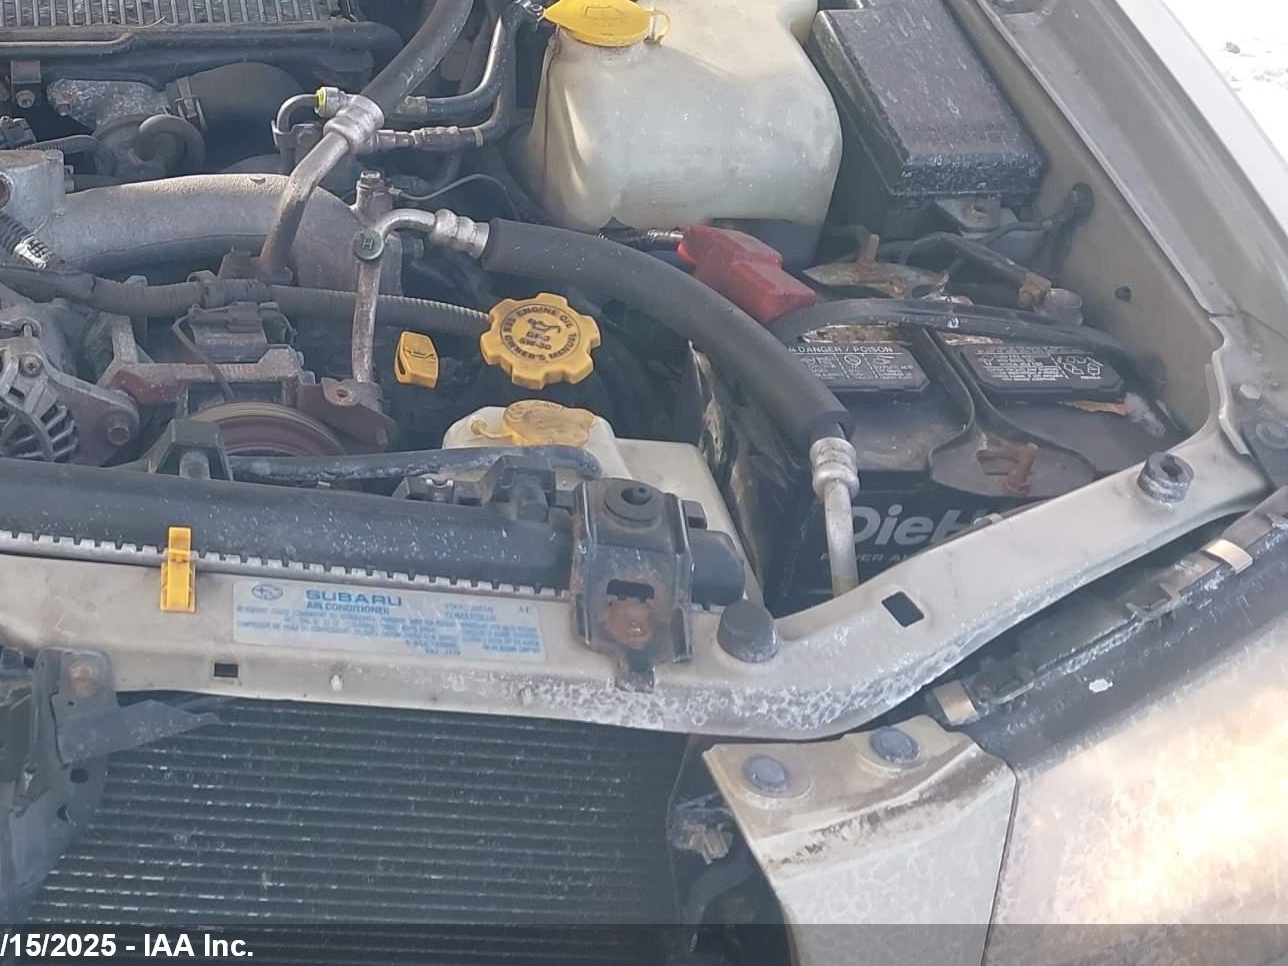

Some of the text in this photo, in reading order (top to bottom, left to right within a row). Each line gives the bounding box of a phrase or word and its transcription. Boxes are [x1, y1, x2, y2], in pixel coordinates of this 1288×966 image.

[516, 306, 573, 329] ENGINE OIL
[306, 590, 402, 606] SUBARU
[325, 602, 390, 615] CONDITIONER
